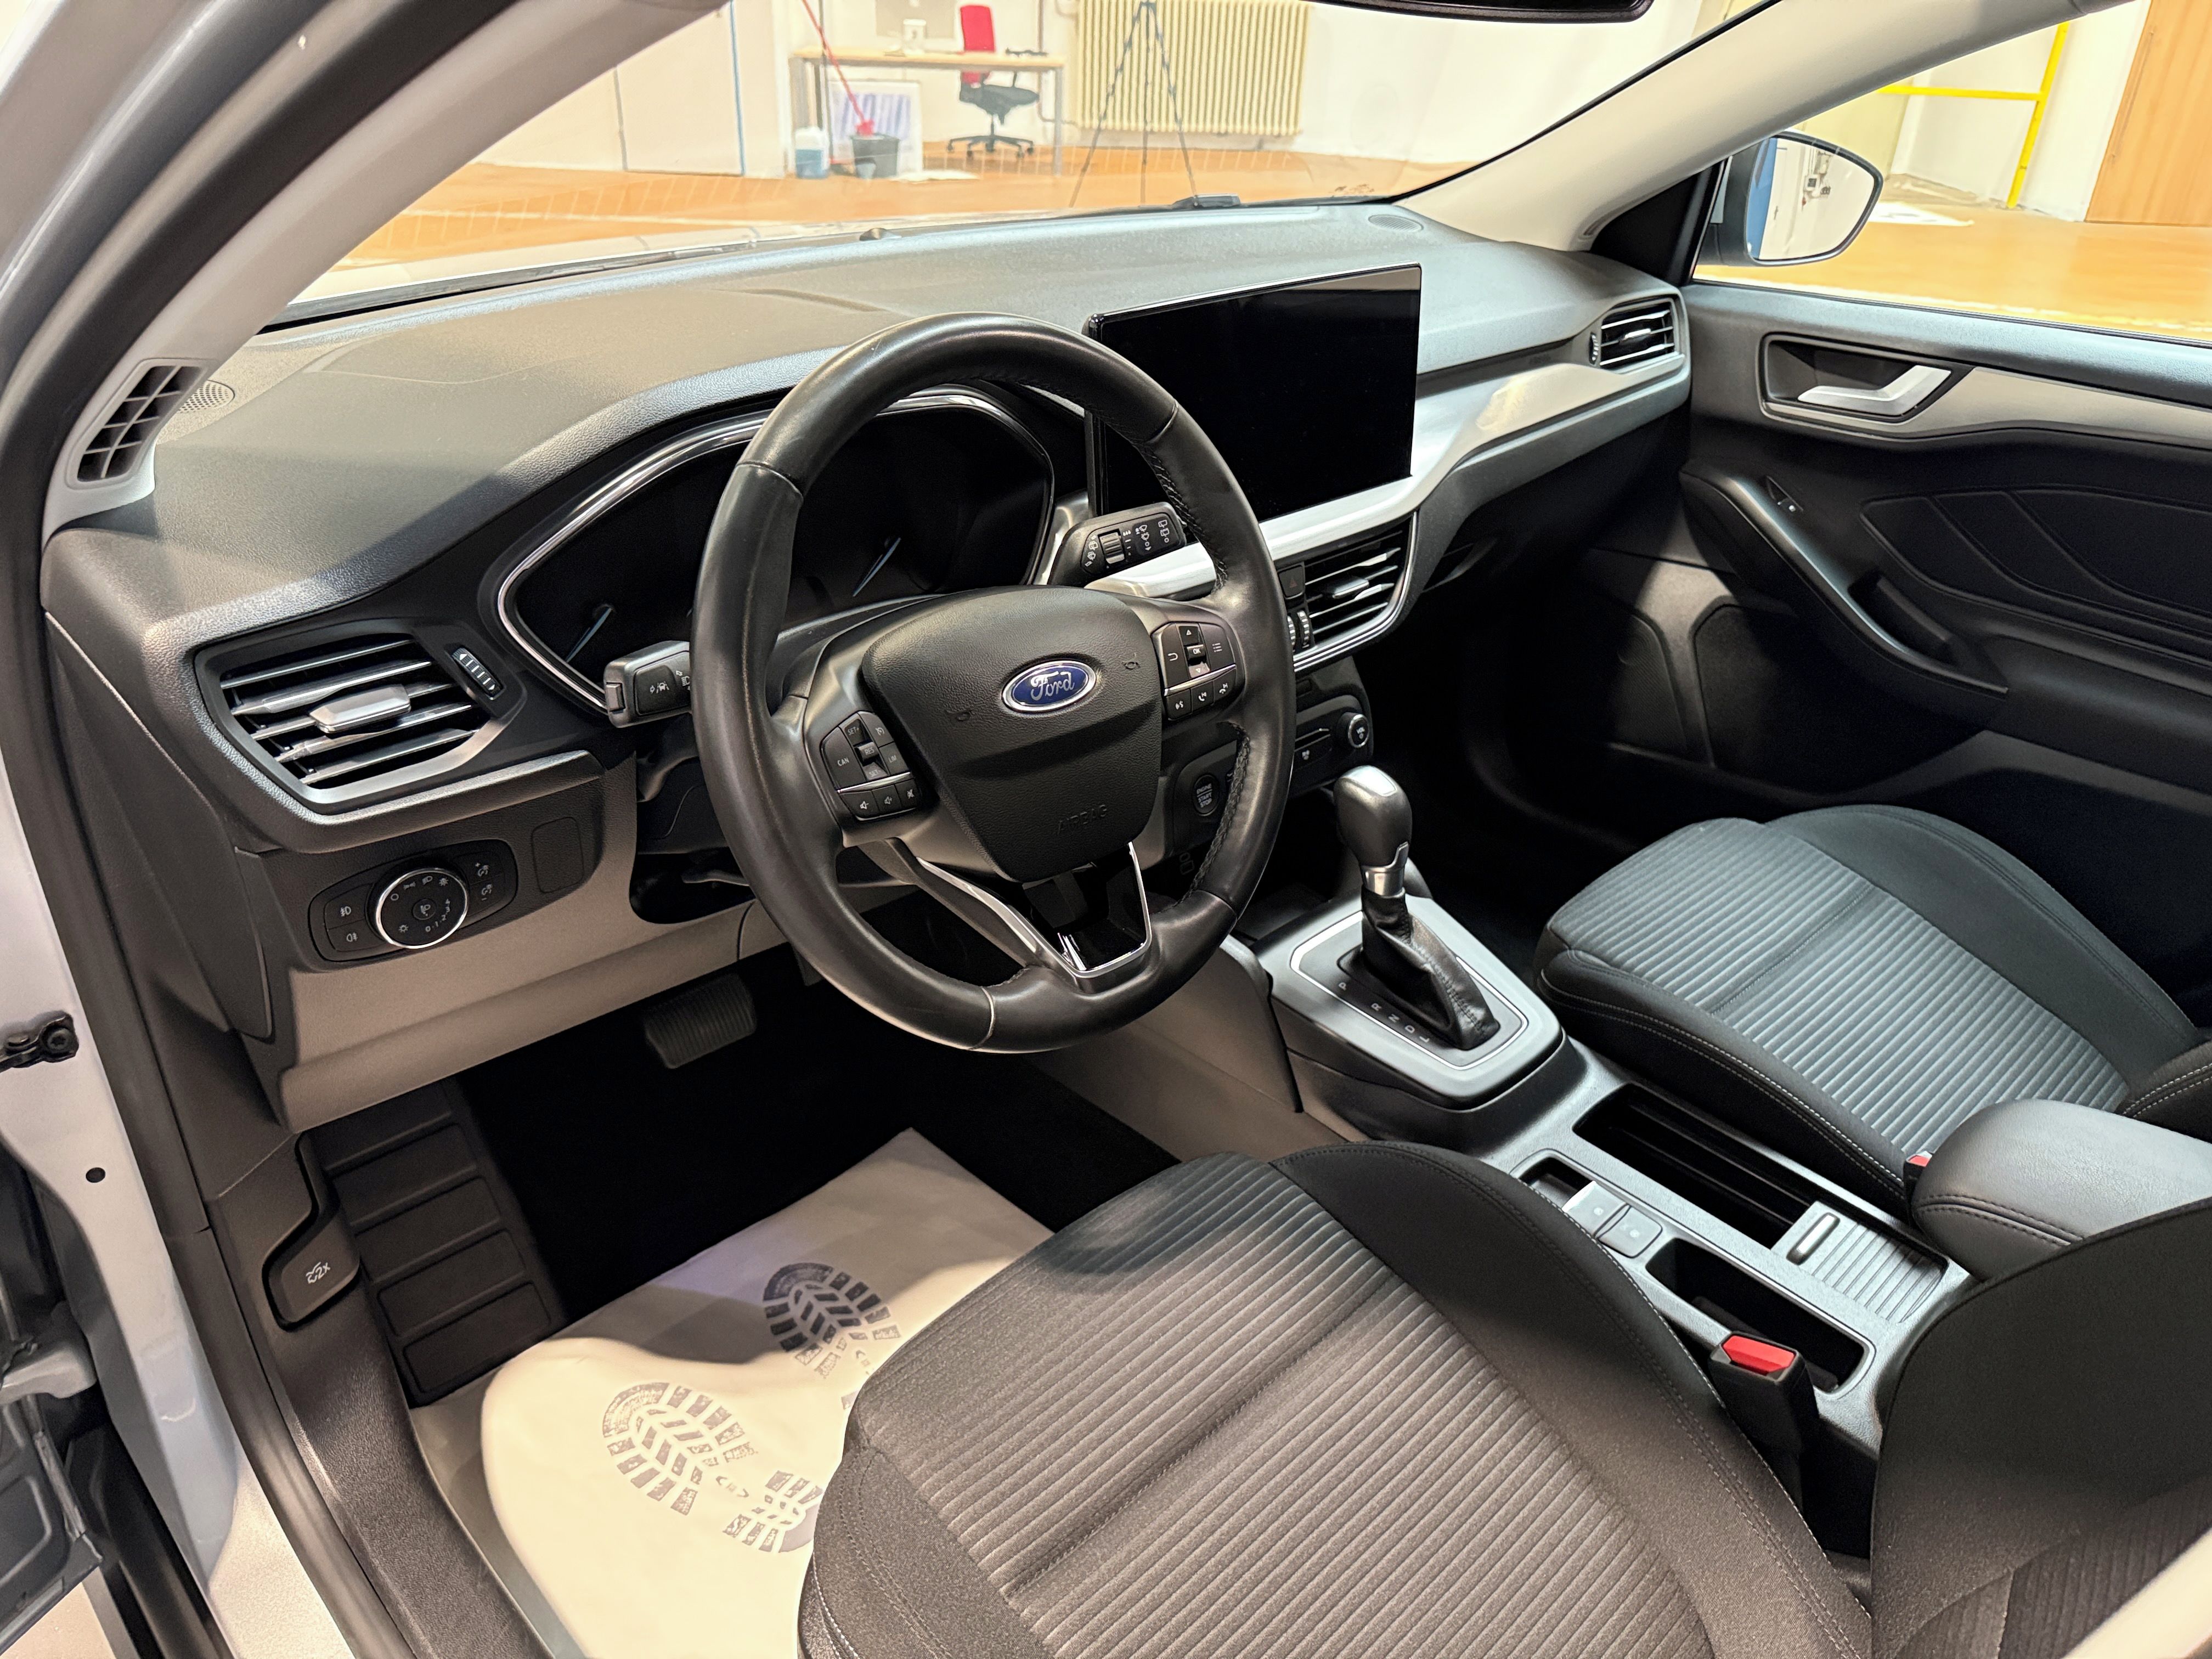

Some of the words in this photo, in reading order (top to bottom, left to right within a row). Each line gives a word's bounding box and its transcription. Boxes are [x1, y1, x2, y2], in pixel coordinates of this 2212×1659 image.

[1030, 670, 1075, 701] Ford
[864, 747, 874, 755] RES
[837, 757, 850, 766] CAN
[1200, 798, 1212, 808] STOP
[1338, 982, 1347, 991] P
[1370, 1002, 1382, 1012] R
[1388, 1013, 1400, 1023] N
[1404, 1025, 1415, 1034] D
